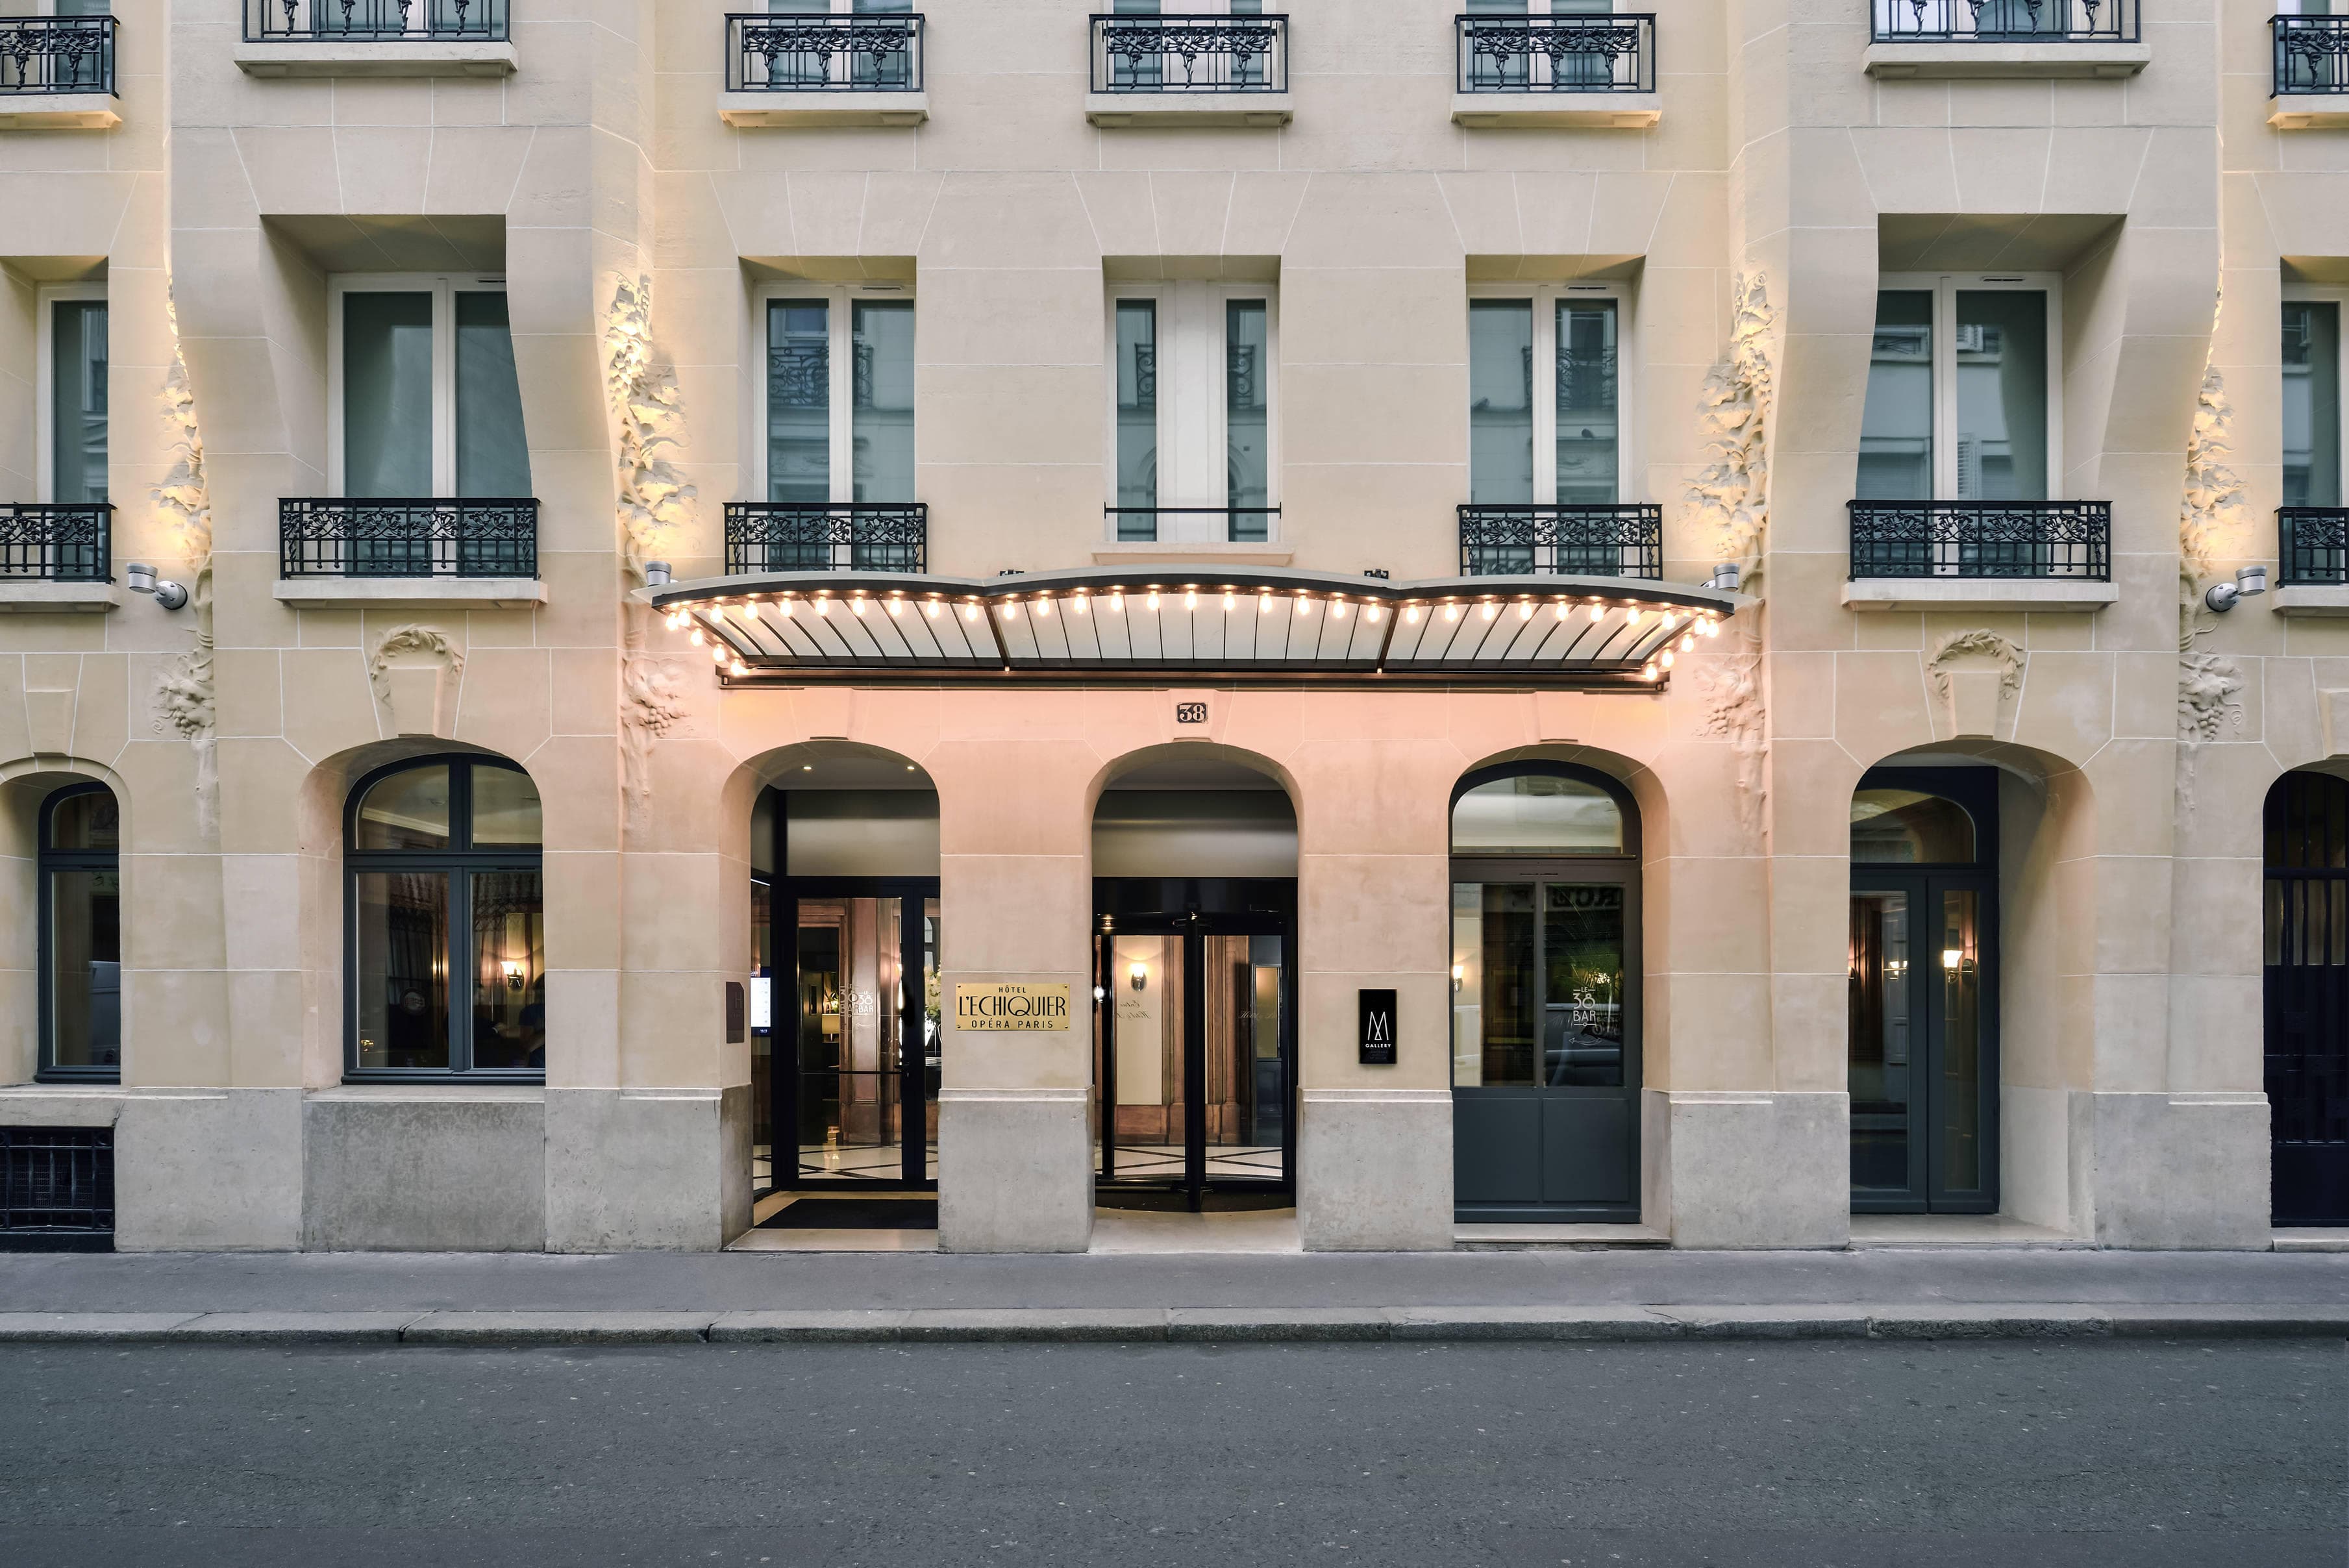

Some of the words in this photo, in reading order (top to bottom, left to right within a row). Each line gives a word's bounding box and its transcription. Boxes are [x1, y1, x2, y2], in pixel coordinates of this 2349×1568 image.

[1179, 704, 1204, 721] 38
[999, 985, 1026, 993] HÔTEL
[858, 994, 873, 1005] 38
[1572, 993, 1596, 1010] 38
[1573, 1010, 1596, 1021] BAR
[971, 1018, 1010, 1028] OPÉRA
[1017, 1020, 1053, 1028] PARIS
